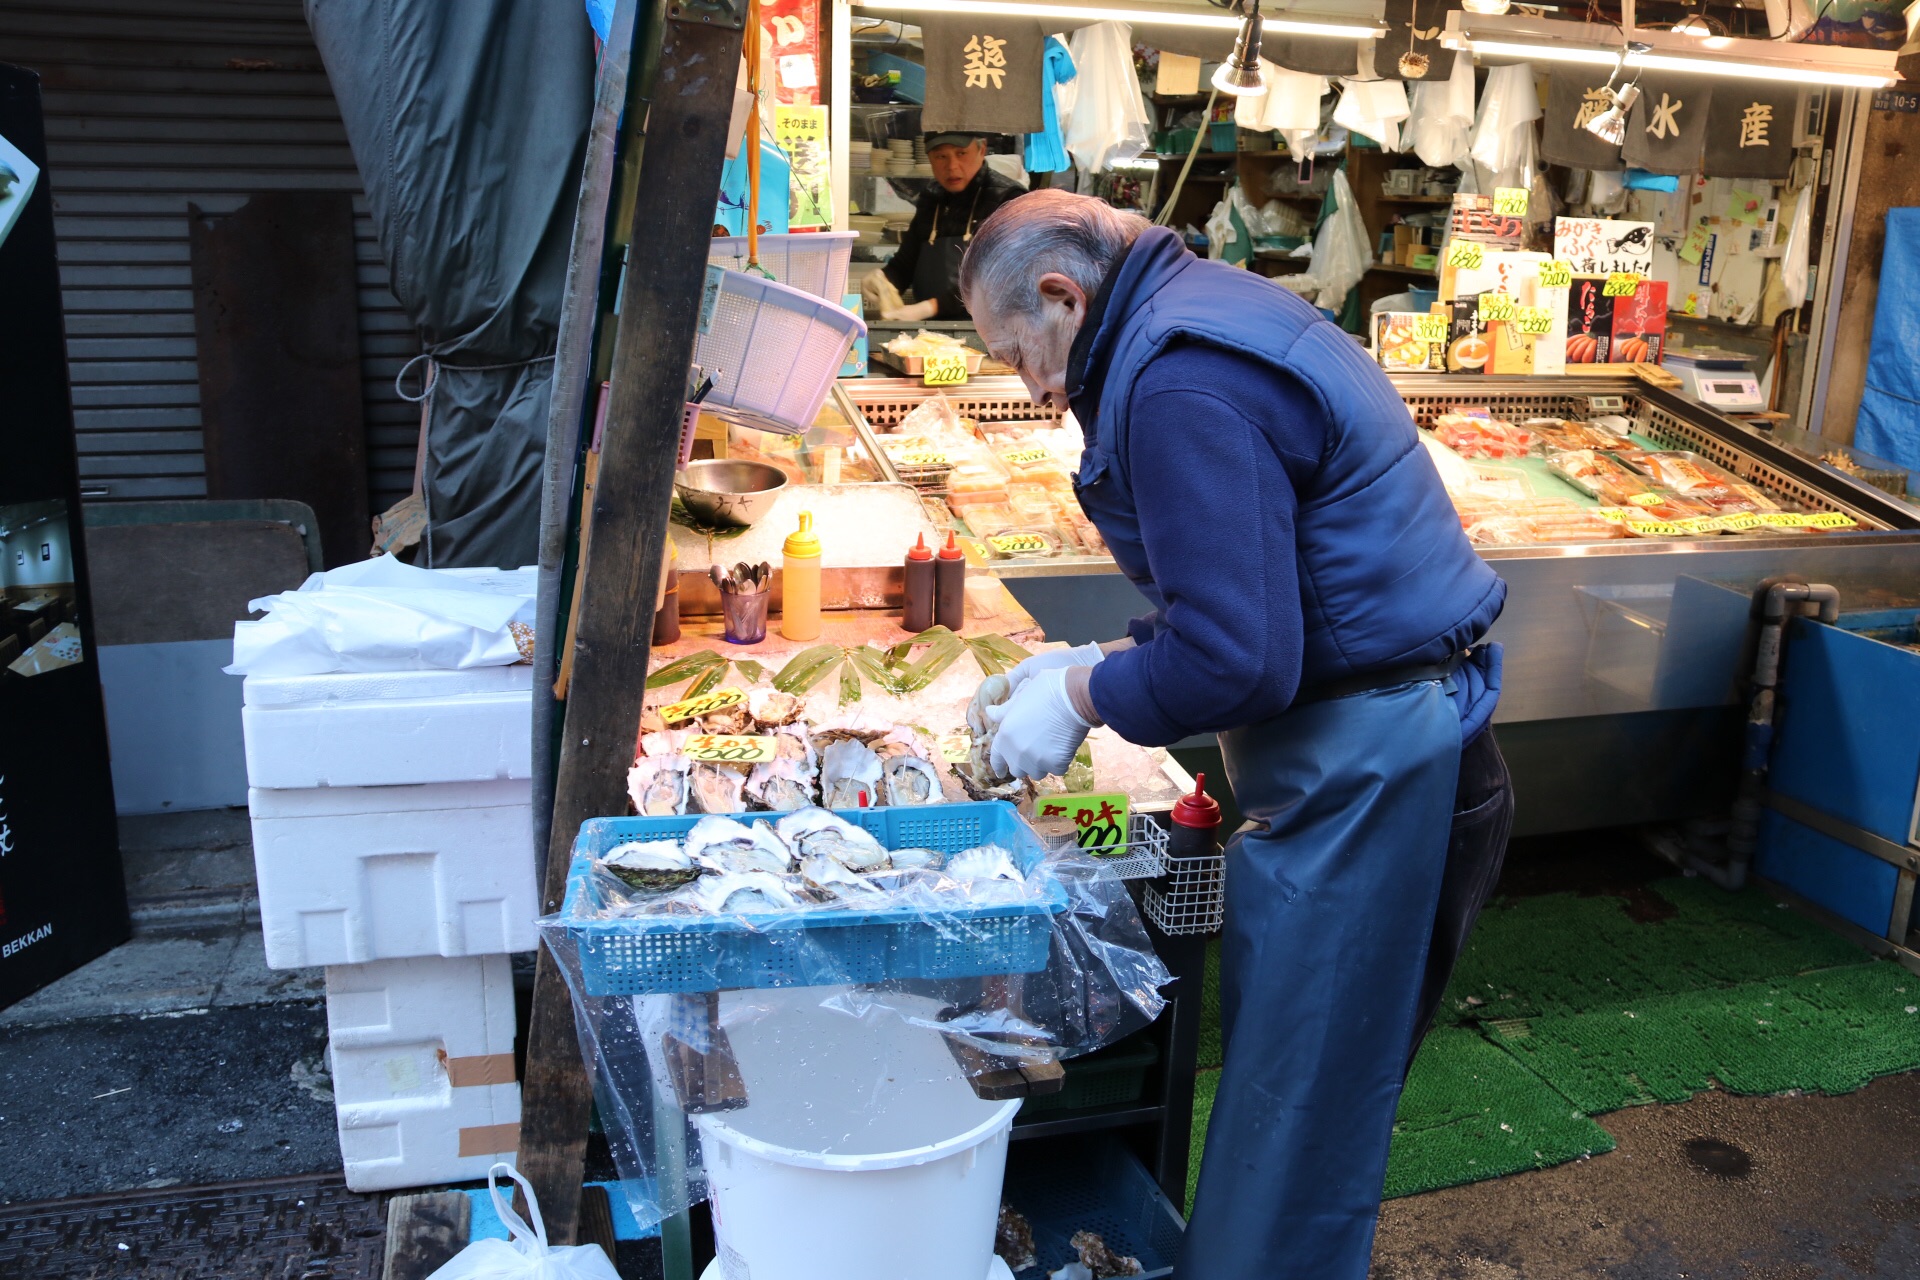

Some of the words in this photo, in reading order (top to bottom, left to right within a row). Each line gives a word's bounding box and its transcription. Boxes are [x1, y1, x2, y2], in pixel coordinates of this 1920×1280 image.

[1894, 95, 1917, 109] 10-5
[1555, 219, 1602, 237] みがき
[1562, 235, 1602, 257] ふぐ
[1450, 250, 1484, 270] 6800
[1416, 322, 1445, 340] 3800
[929, 365, 966, 382] 2000
[1001, 542, 1044, 551] 2000
[693, 736, 763, 750] 生カキ
[699, 747, 764, 760] 500
[1076, 823, 1122, 855] 00
[2, 922, 53, 958] BEKKAN
